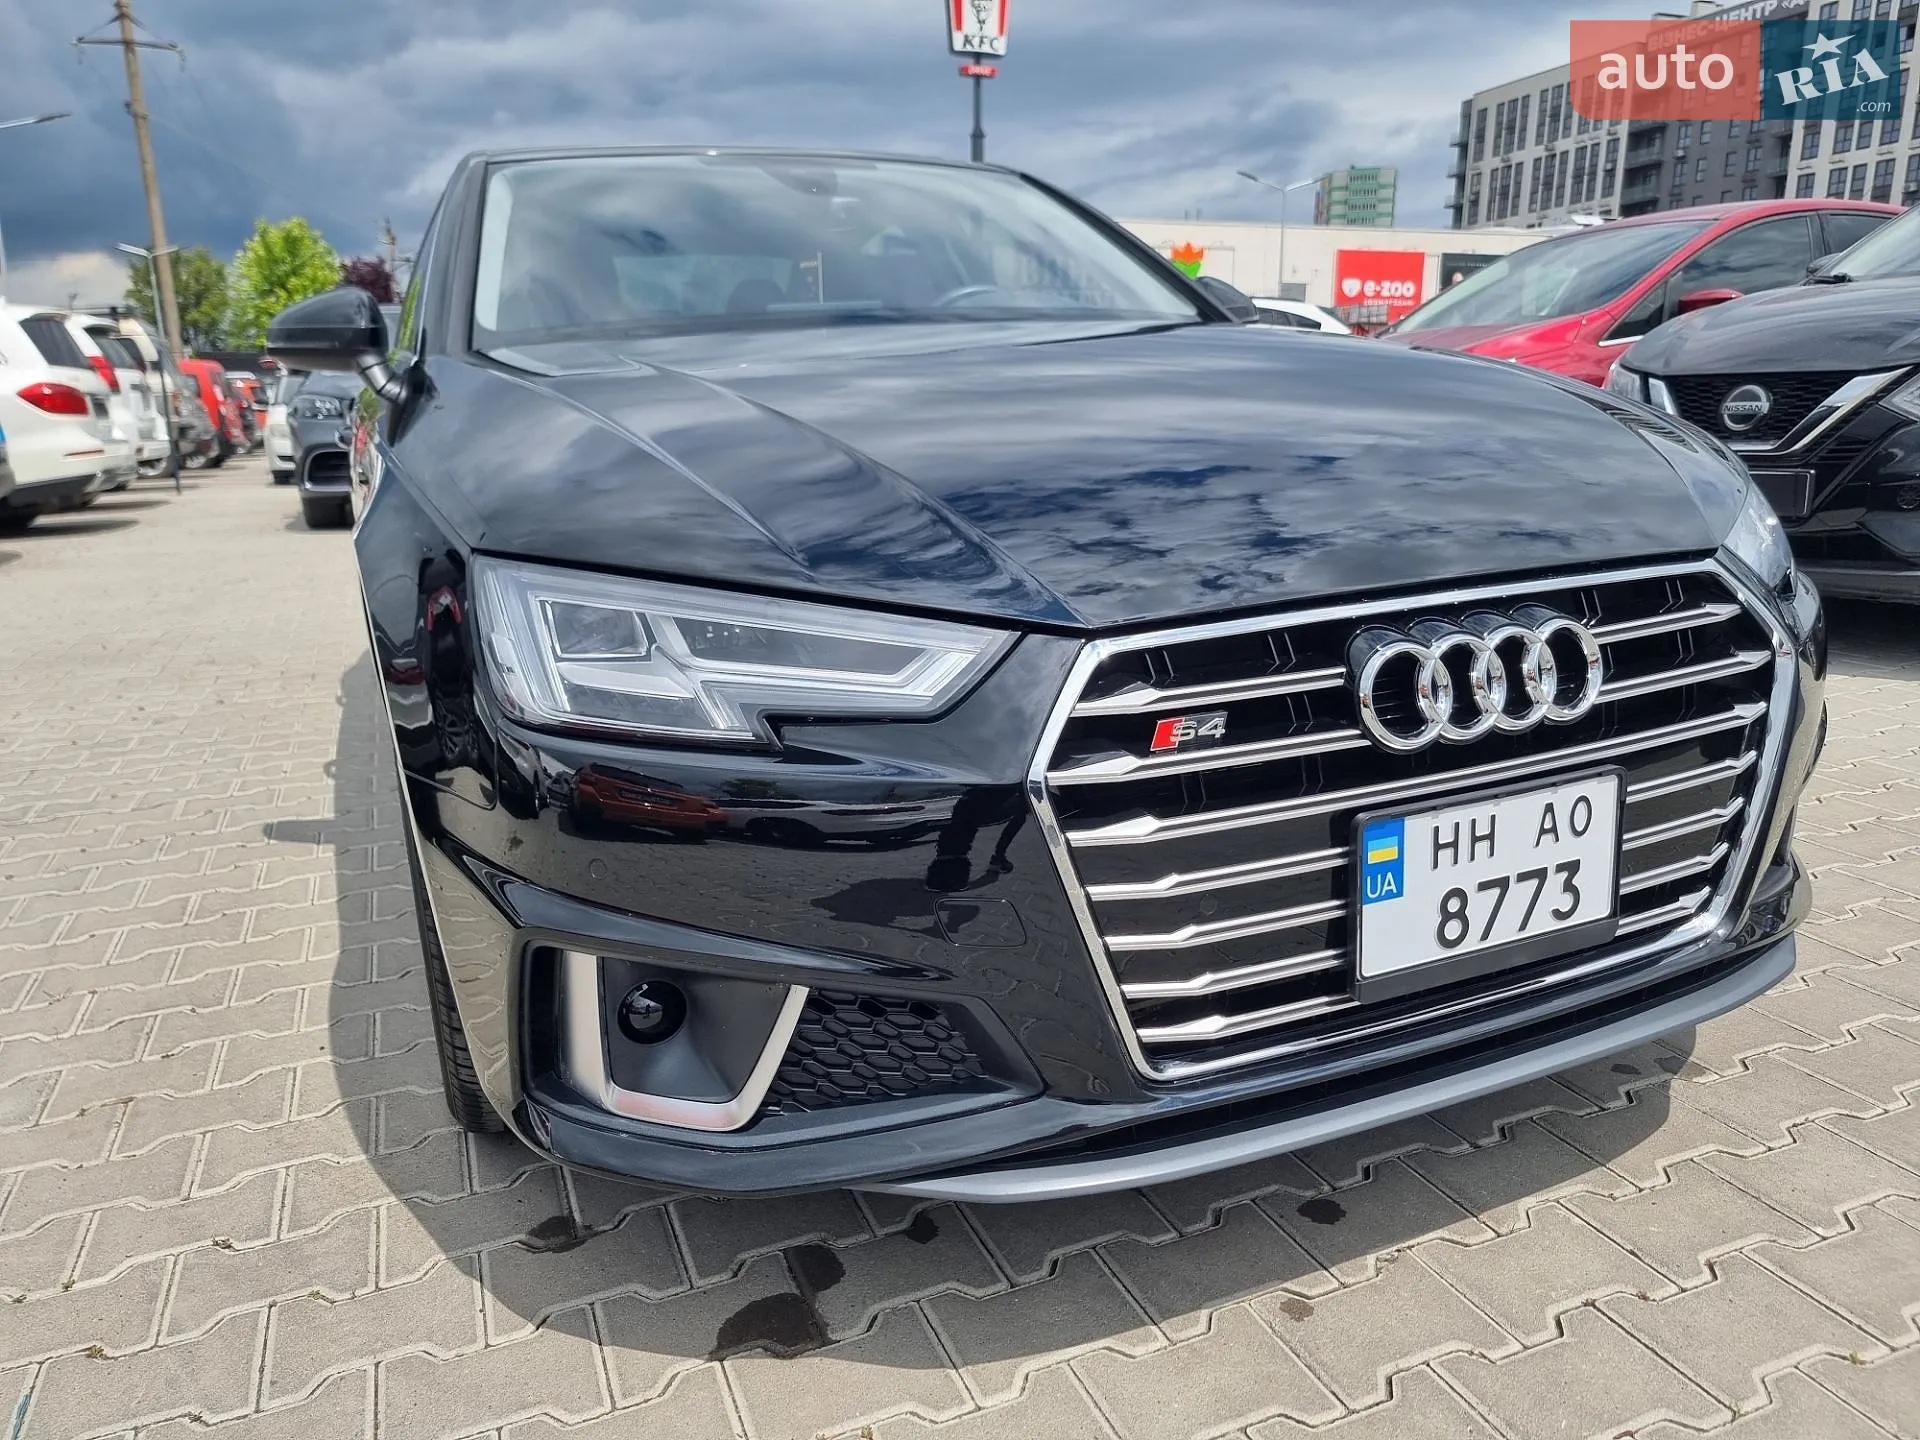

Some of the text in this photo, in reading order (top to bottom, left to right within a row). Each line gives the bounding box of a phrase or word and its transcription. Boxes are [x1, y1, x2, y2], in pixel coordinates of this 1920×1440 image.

[963, 34, 999, 52] KFC
[1723, 403, 1763, 413] NISSAN
[1169, 717, 1226, 742] S4
[1430, 813, 1497, 870] HH
[1366, 872, 1398, 899] UA
[1436, 858, 1582, 949] 8773
